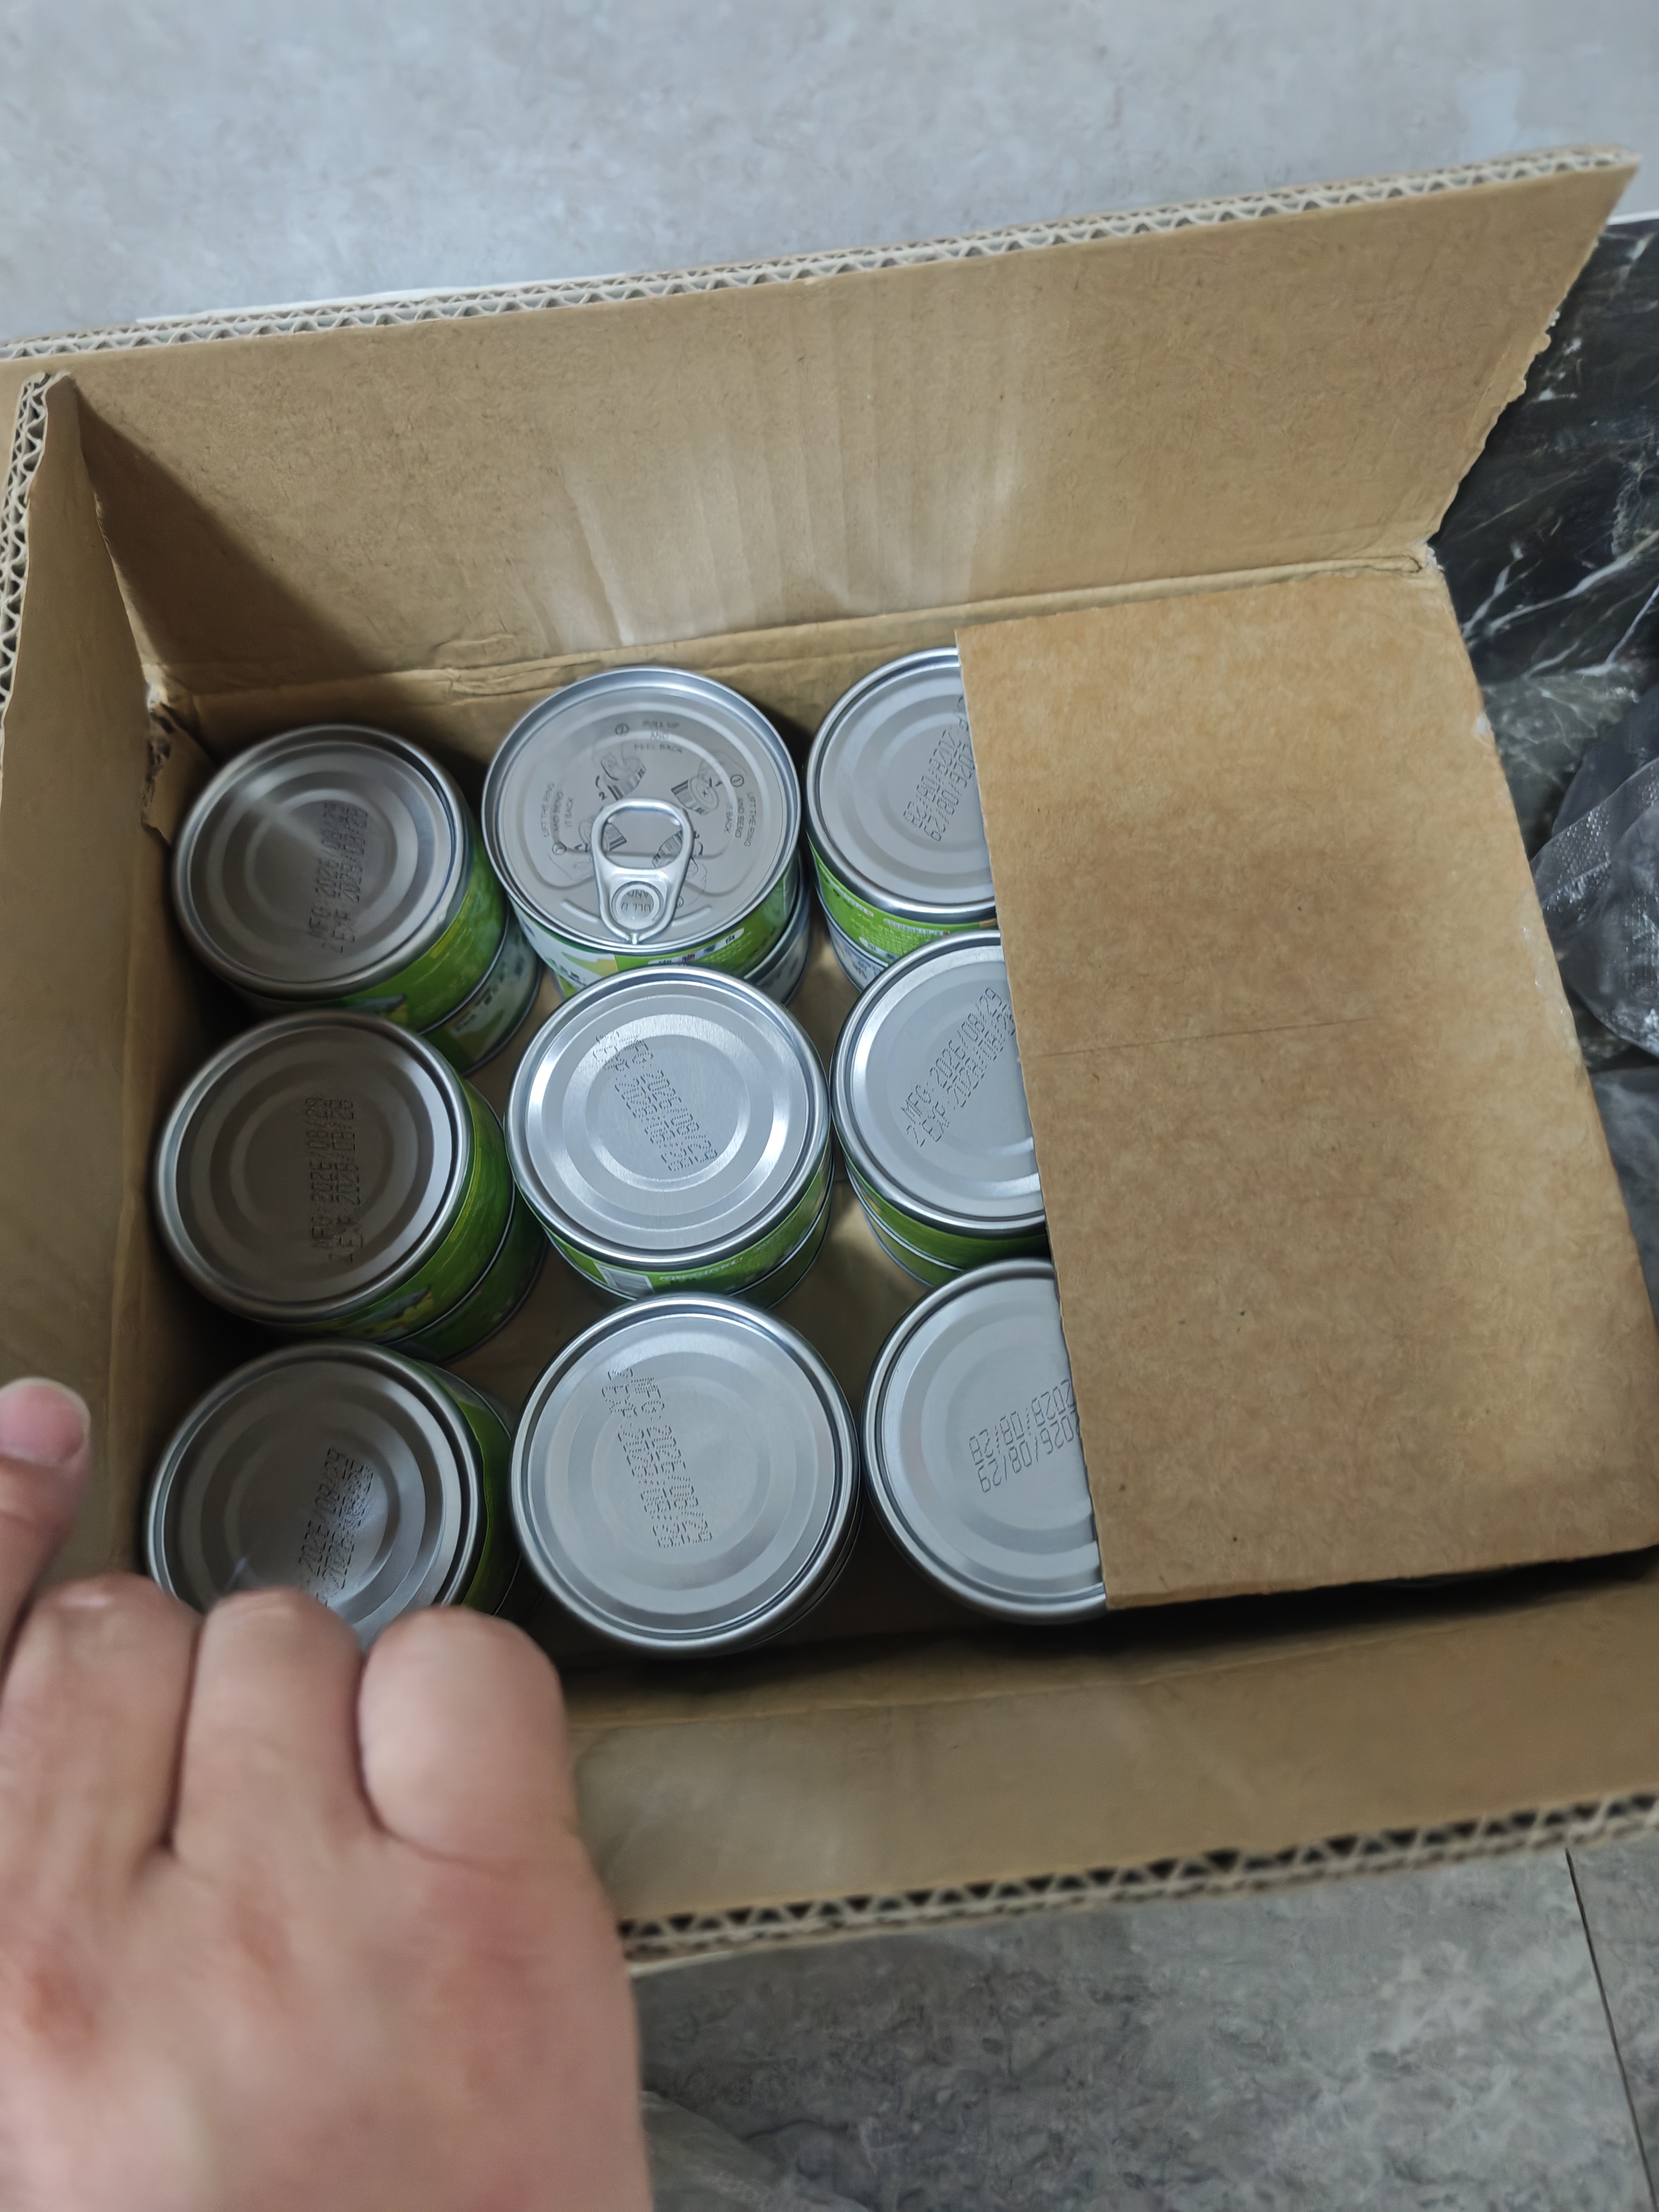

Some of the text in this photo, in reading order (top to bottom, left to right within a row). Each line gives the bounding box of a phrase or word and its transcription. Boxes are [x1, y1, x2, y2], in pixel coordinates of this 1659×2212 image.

[899, 986, 1004, 1125] MFG: 2026/08/29
[639, 1069, 719, 1165] 2026/08/29
[918, 1100, 957, 1143] EXP:
[616, 1428, 686, 1548] 2028/08/28
[630, 1376, 713, 1543] MFG: 2026/08/29
